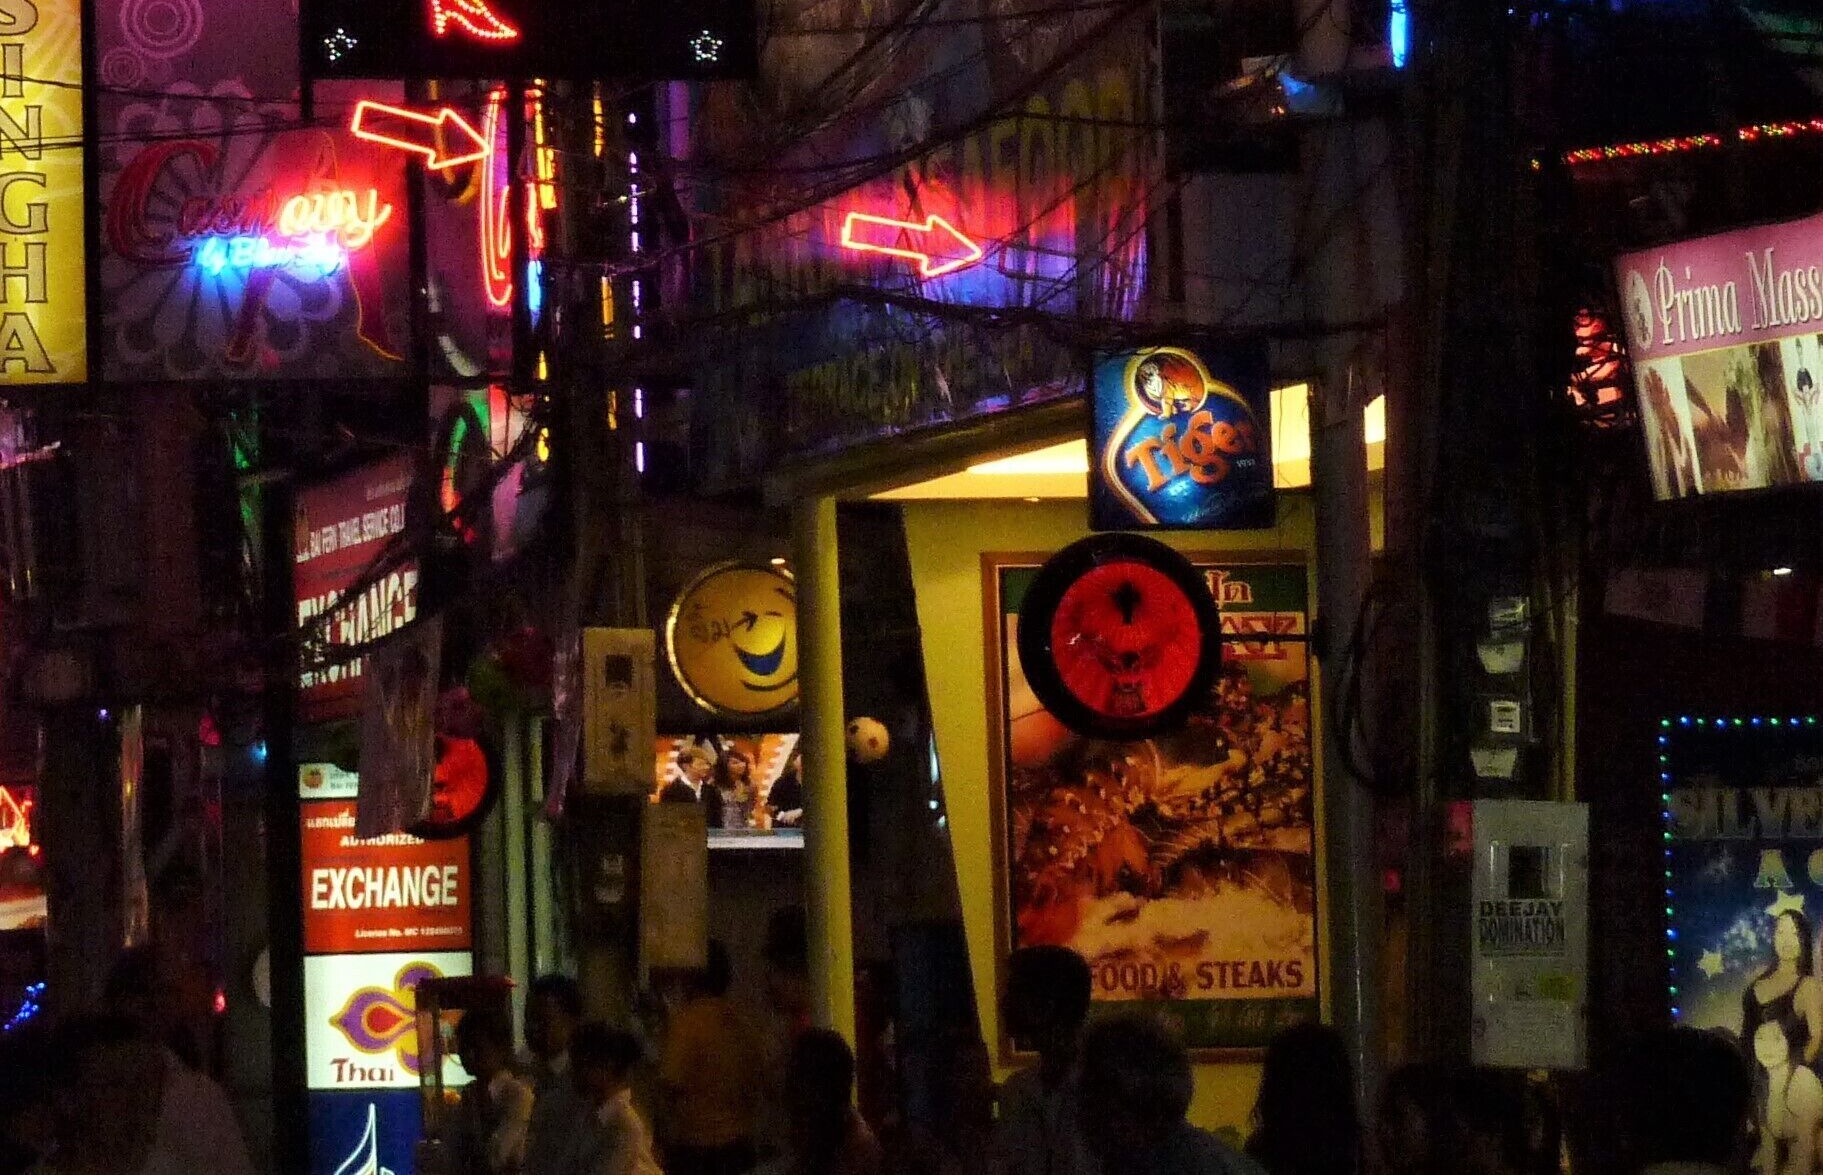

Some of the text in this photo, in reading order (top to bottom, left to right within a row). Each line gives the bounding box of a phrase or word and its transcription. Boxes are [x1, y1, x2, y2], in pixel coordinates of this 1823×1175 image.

[1653, 256, 1743, 346] Prima
[311, 865, 459, 910] EXCHANGE
[1479, 901, 1563, 917] DEEJAY
[1194, 959, 1305, 991] STEAKS
[330, 1057, 395, 1083] Thai
